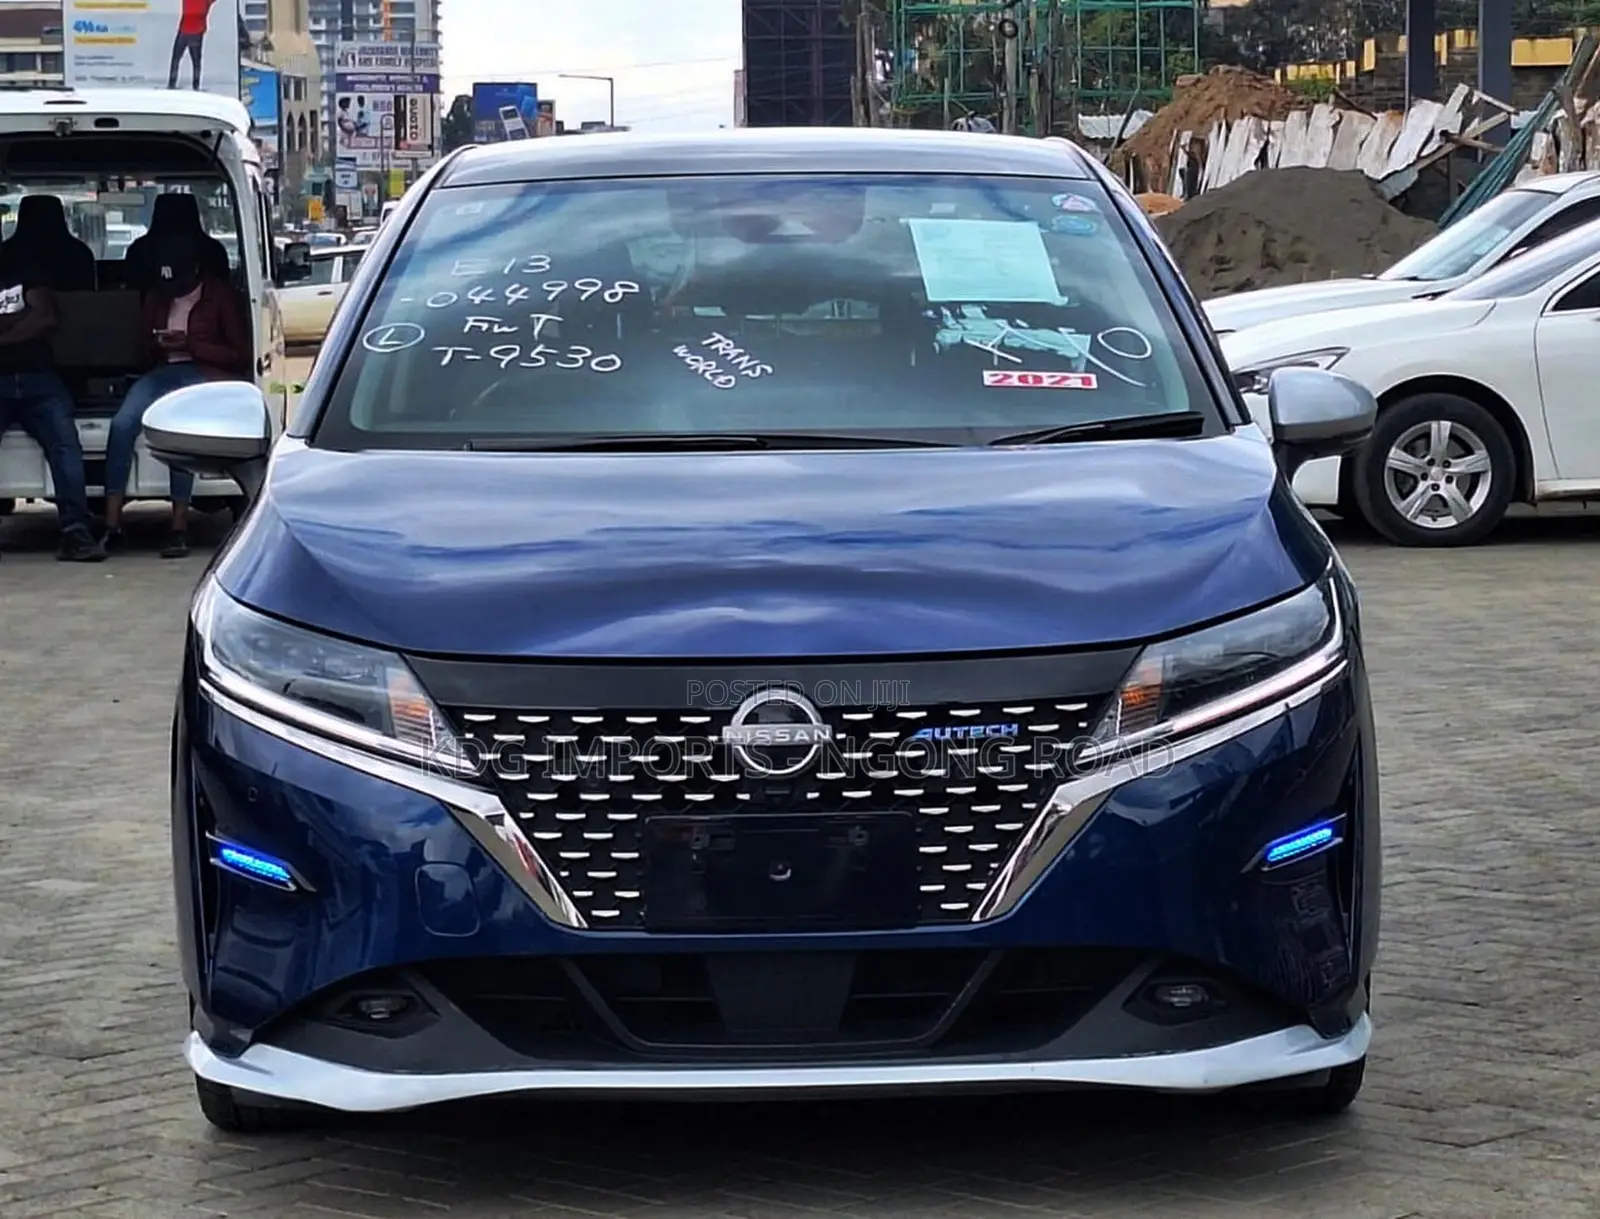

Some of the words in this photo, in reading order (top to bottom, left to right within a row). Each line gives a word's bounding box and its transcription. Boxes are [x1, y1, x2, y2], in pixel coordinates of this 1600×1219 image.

[431, 345, 623, 374] T-9530
[701, 331, 775, 381] TRANS
[987, 373, 1094, 387] 2021
[725, 727, 831, 743] NISSAN
[912, 723, 1019, 741] AUTECH
